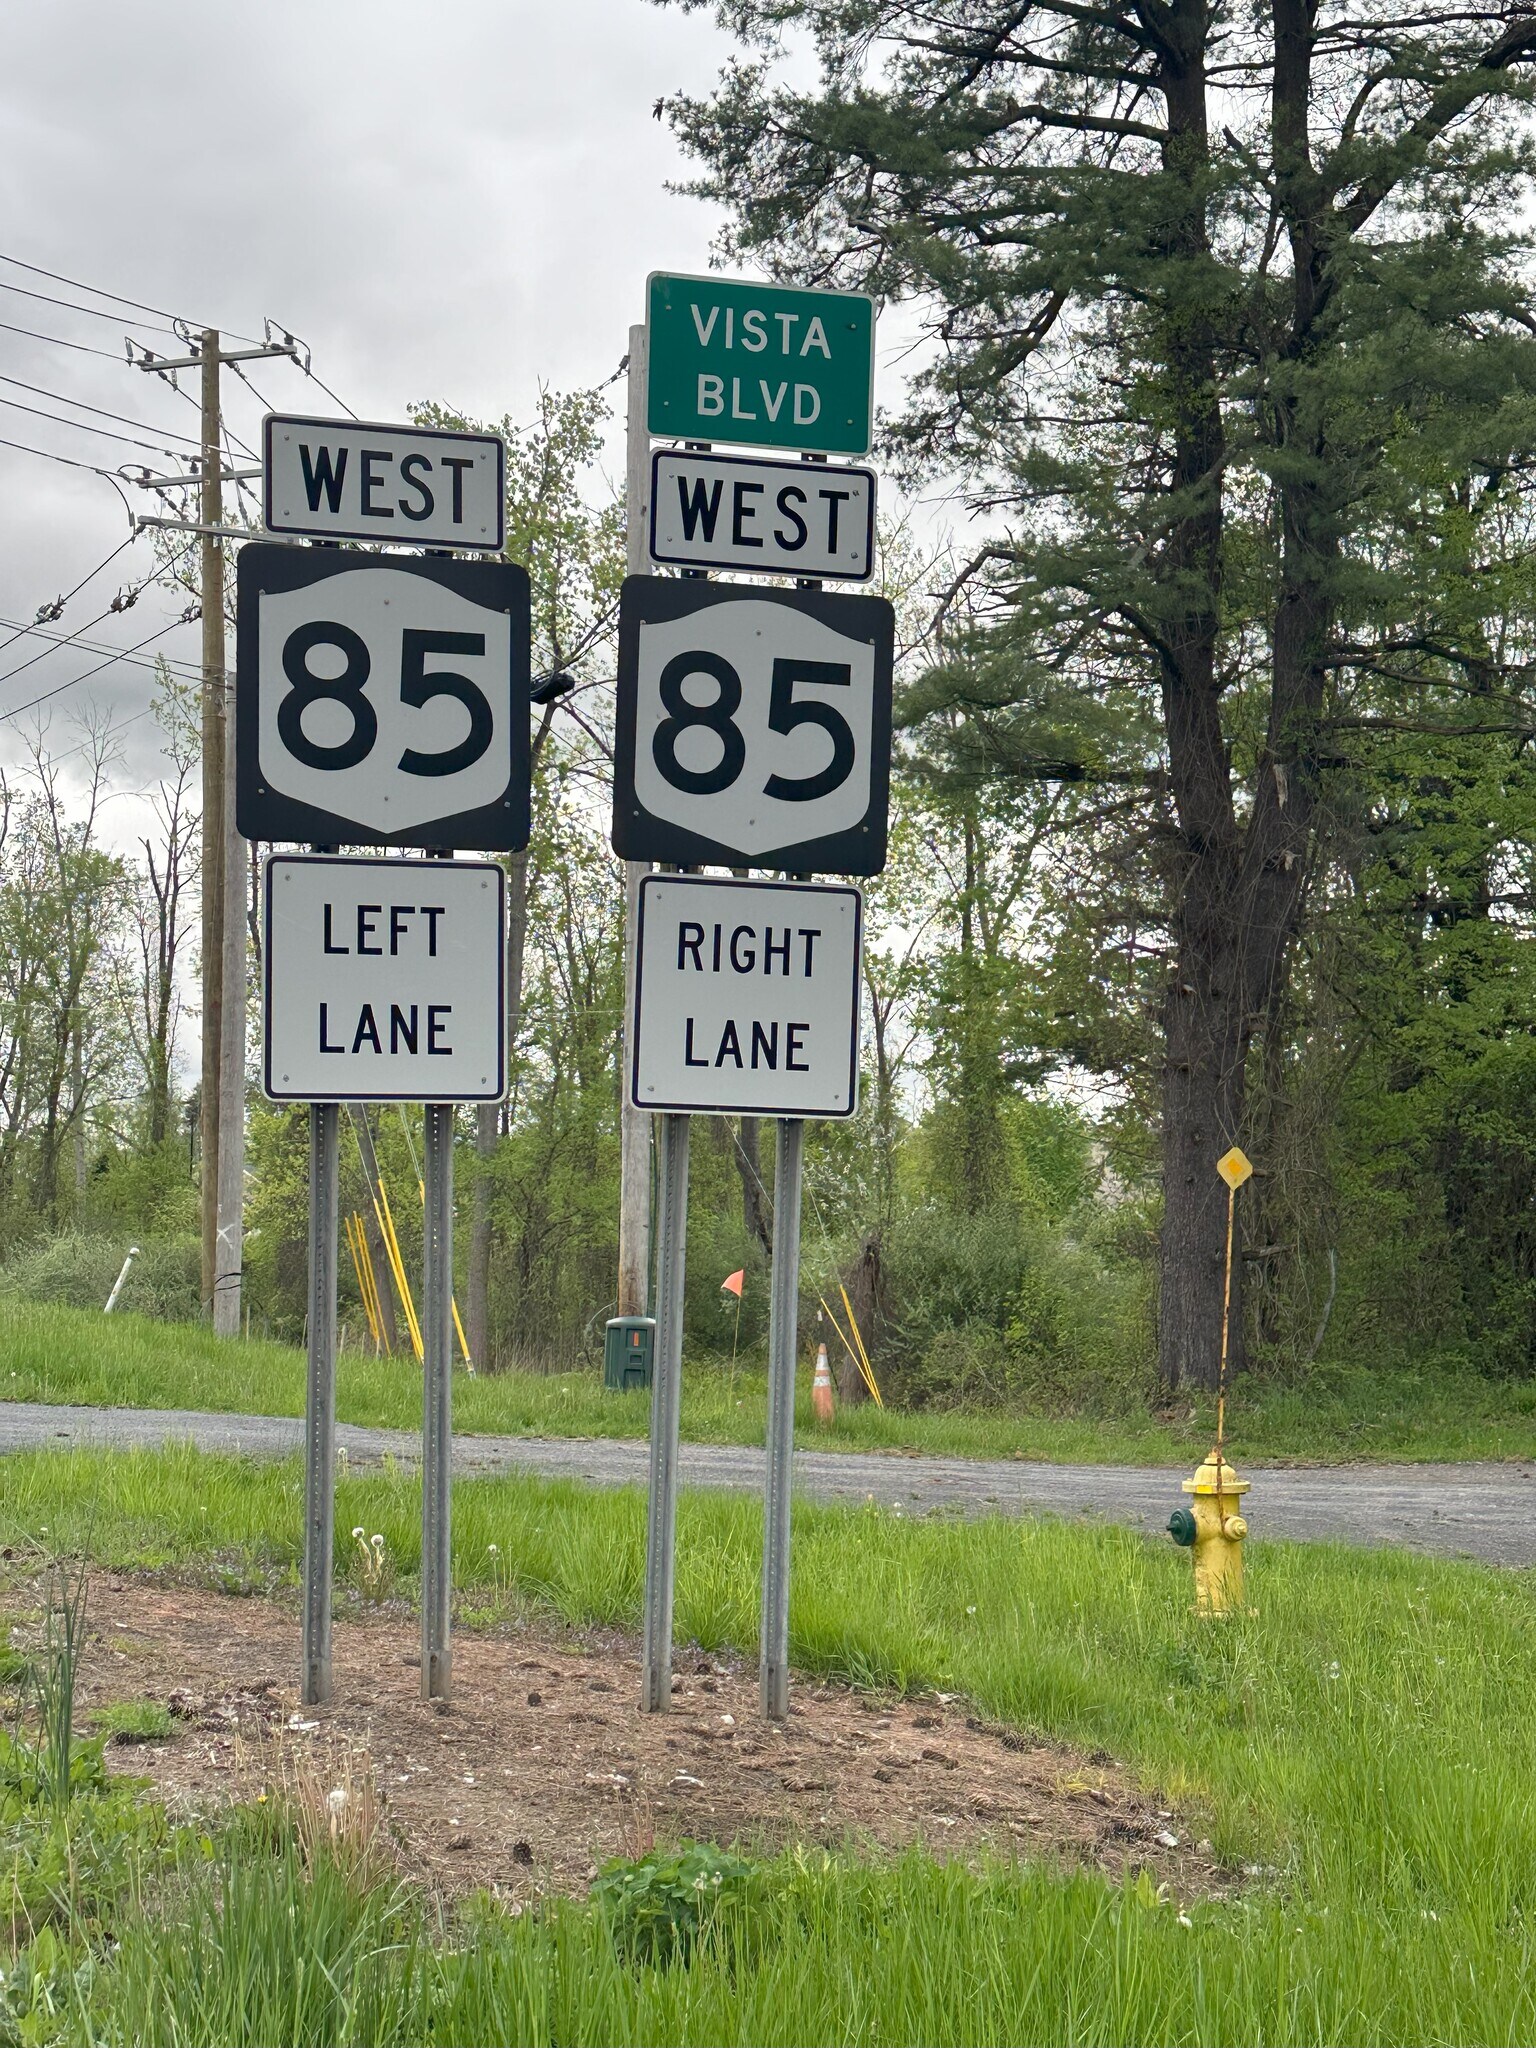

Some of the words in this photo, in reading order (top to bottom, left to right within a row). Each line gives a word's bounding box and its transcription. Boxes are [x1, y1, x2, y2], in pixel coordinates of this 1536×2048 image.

[690, 303, 832, 359] VISTA
[697, 374, 821, 425] BLVD
[298, 444, 474, 524] WEST
[677, 476, 850, 554] WEST
[277, 620, 494, 777] 85
[652, 650, 856, 802] 85
[322, 903, 446, 957] LEFT
[677, 921, 822, 977] RIGHT
[318, 1002, 453, 1055] LANE
[685, 1017, 811, 1072] LANE
